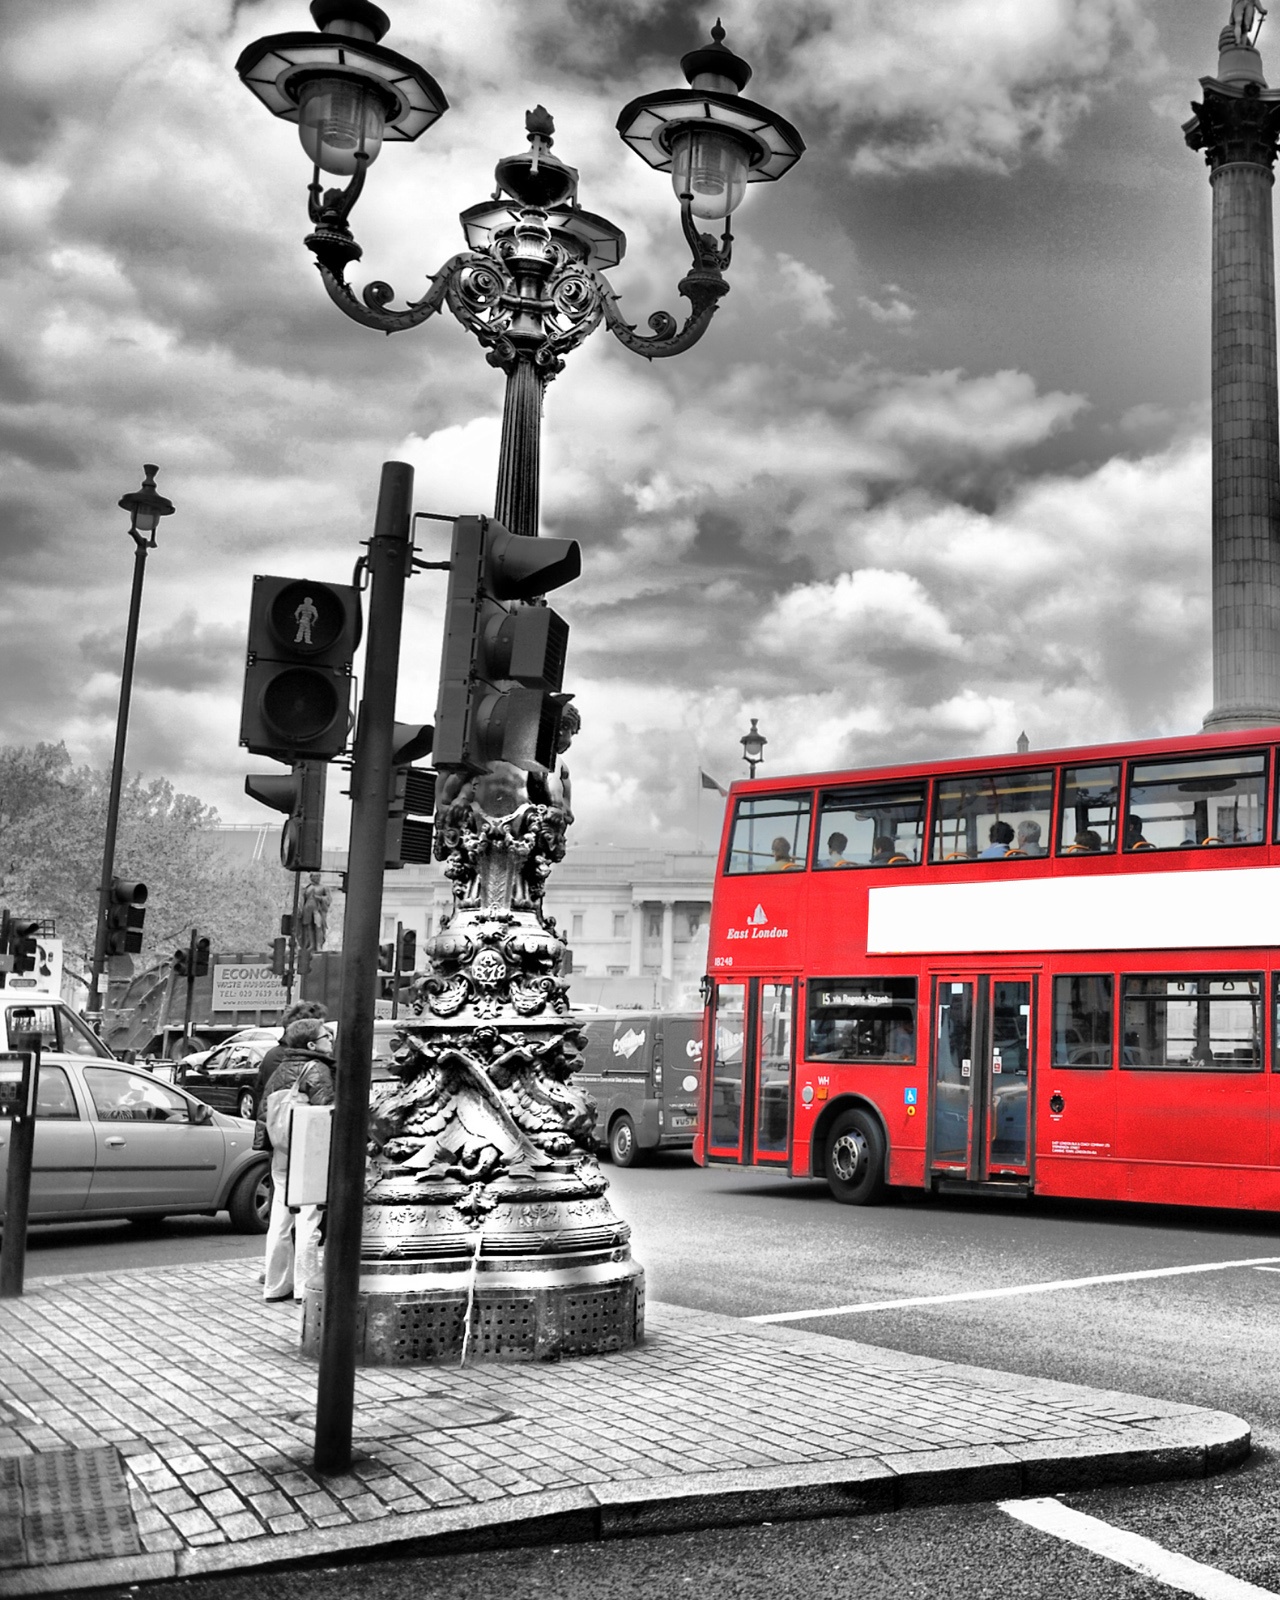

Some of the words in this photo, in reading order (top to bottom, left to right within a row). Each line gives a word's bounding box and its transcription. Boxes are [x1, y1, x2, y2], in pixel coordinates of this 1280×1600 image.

[726, 928, 749, 939] East
[751, 927, 788, 939] London
[714, 956, 733, 966] 18248
[822, 993, 831, 1005] 15
[832, 994, 842, 1004] via
[842, 993, 866, 1006] Regent
[867, 993, 889, 1004] Street
[817, 1075, 830, 1086] WH
